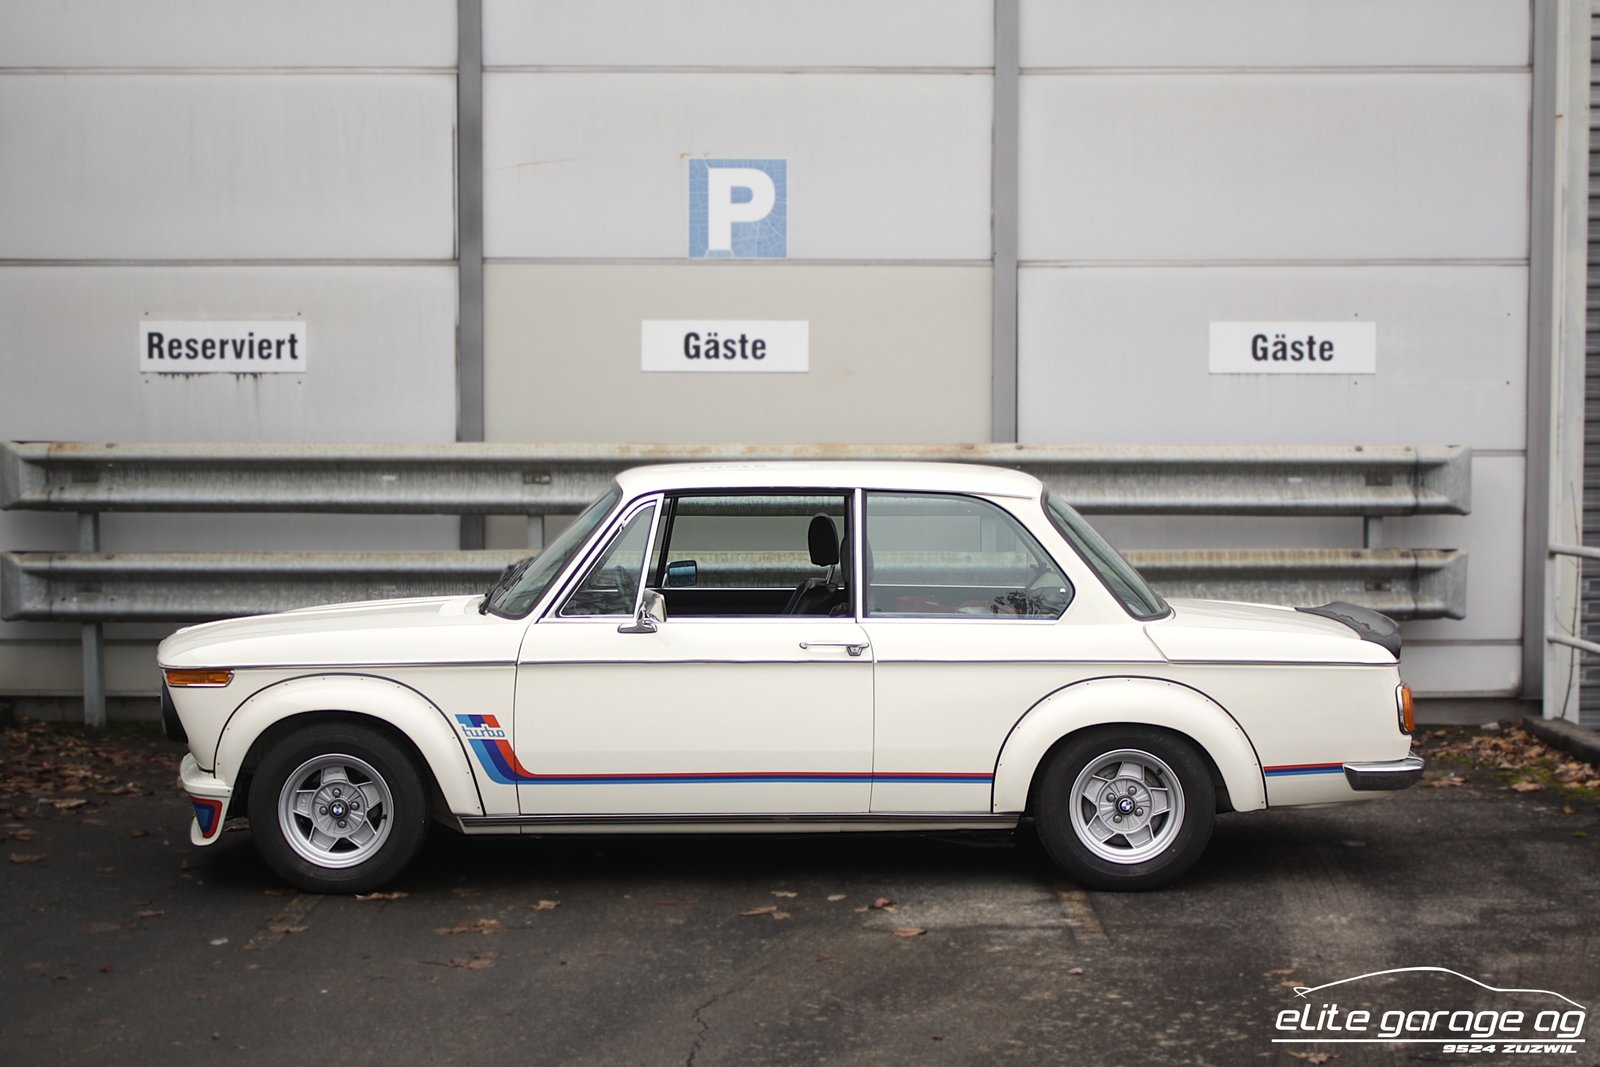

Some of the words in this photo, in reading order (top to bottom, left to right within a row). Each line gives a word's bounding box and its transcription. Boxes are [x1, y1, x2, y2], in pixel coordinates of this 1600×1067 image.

[708, 168, 776, 251] P
[147, 332, 299, 361] Reserviert
[683, 333, 766, 360] Gäste
[1251, 334, 1334, 362] Gäste
[461, 724, 506, 738] turbo
